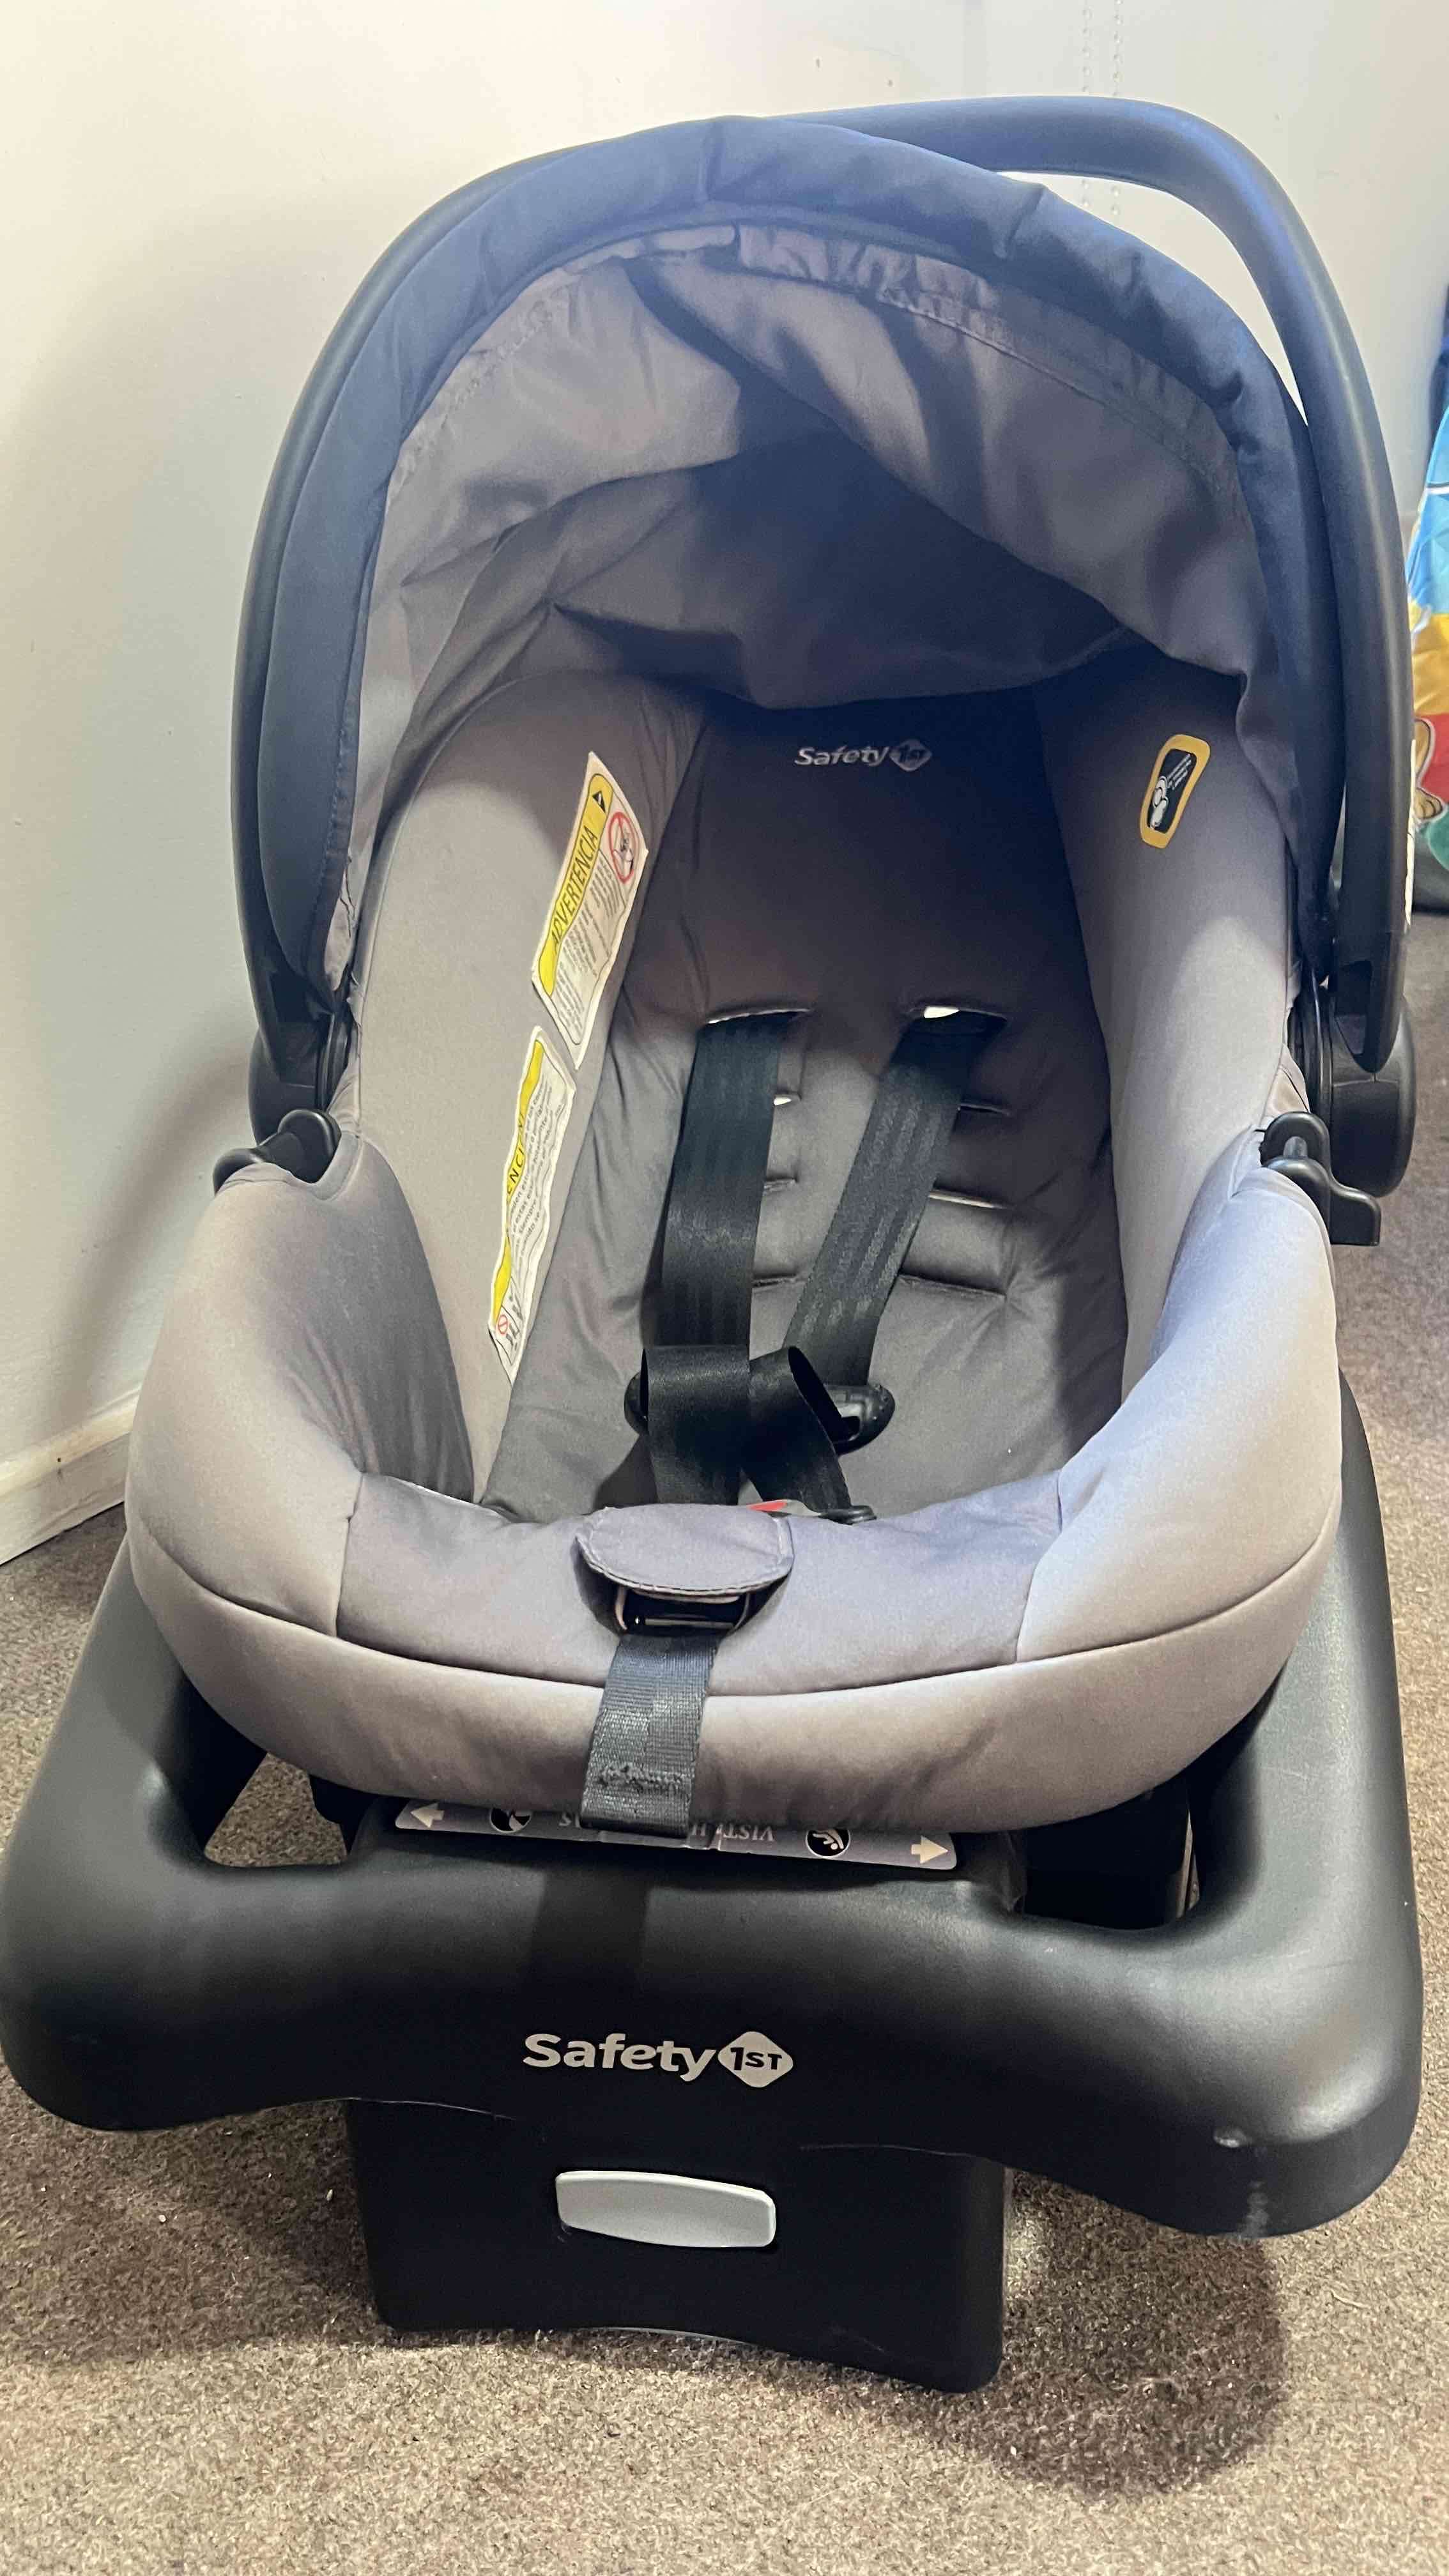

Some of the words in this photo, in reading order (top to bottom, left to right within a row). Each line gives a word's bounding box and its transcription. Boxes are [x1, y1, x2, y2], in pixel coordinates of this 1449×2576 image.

[794, 745, 889, 767] Safety
[552, 825, 598, 954] ADVERTENCIA
[523, 2033, 716, 2082] Safety
[730, 2047, 782, 2071] 1ST
